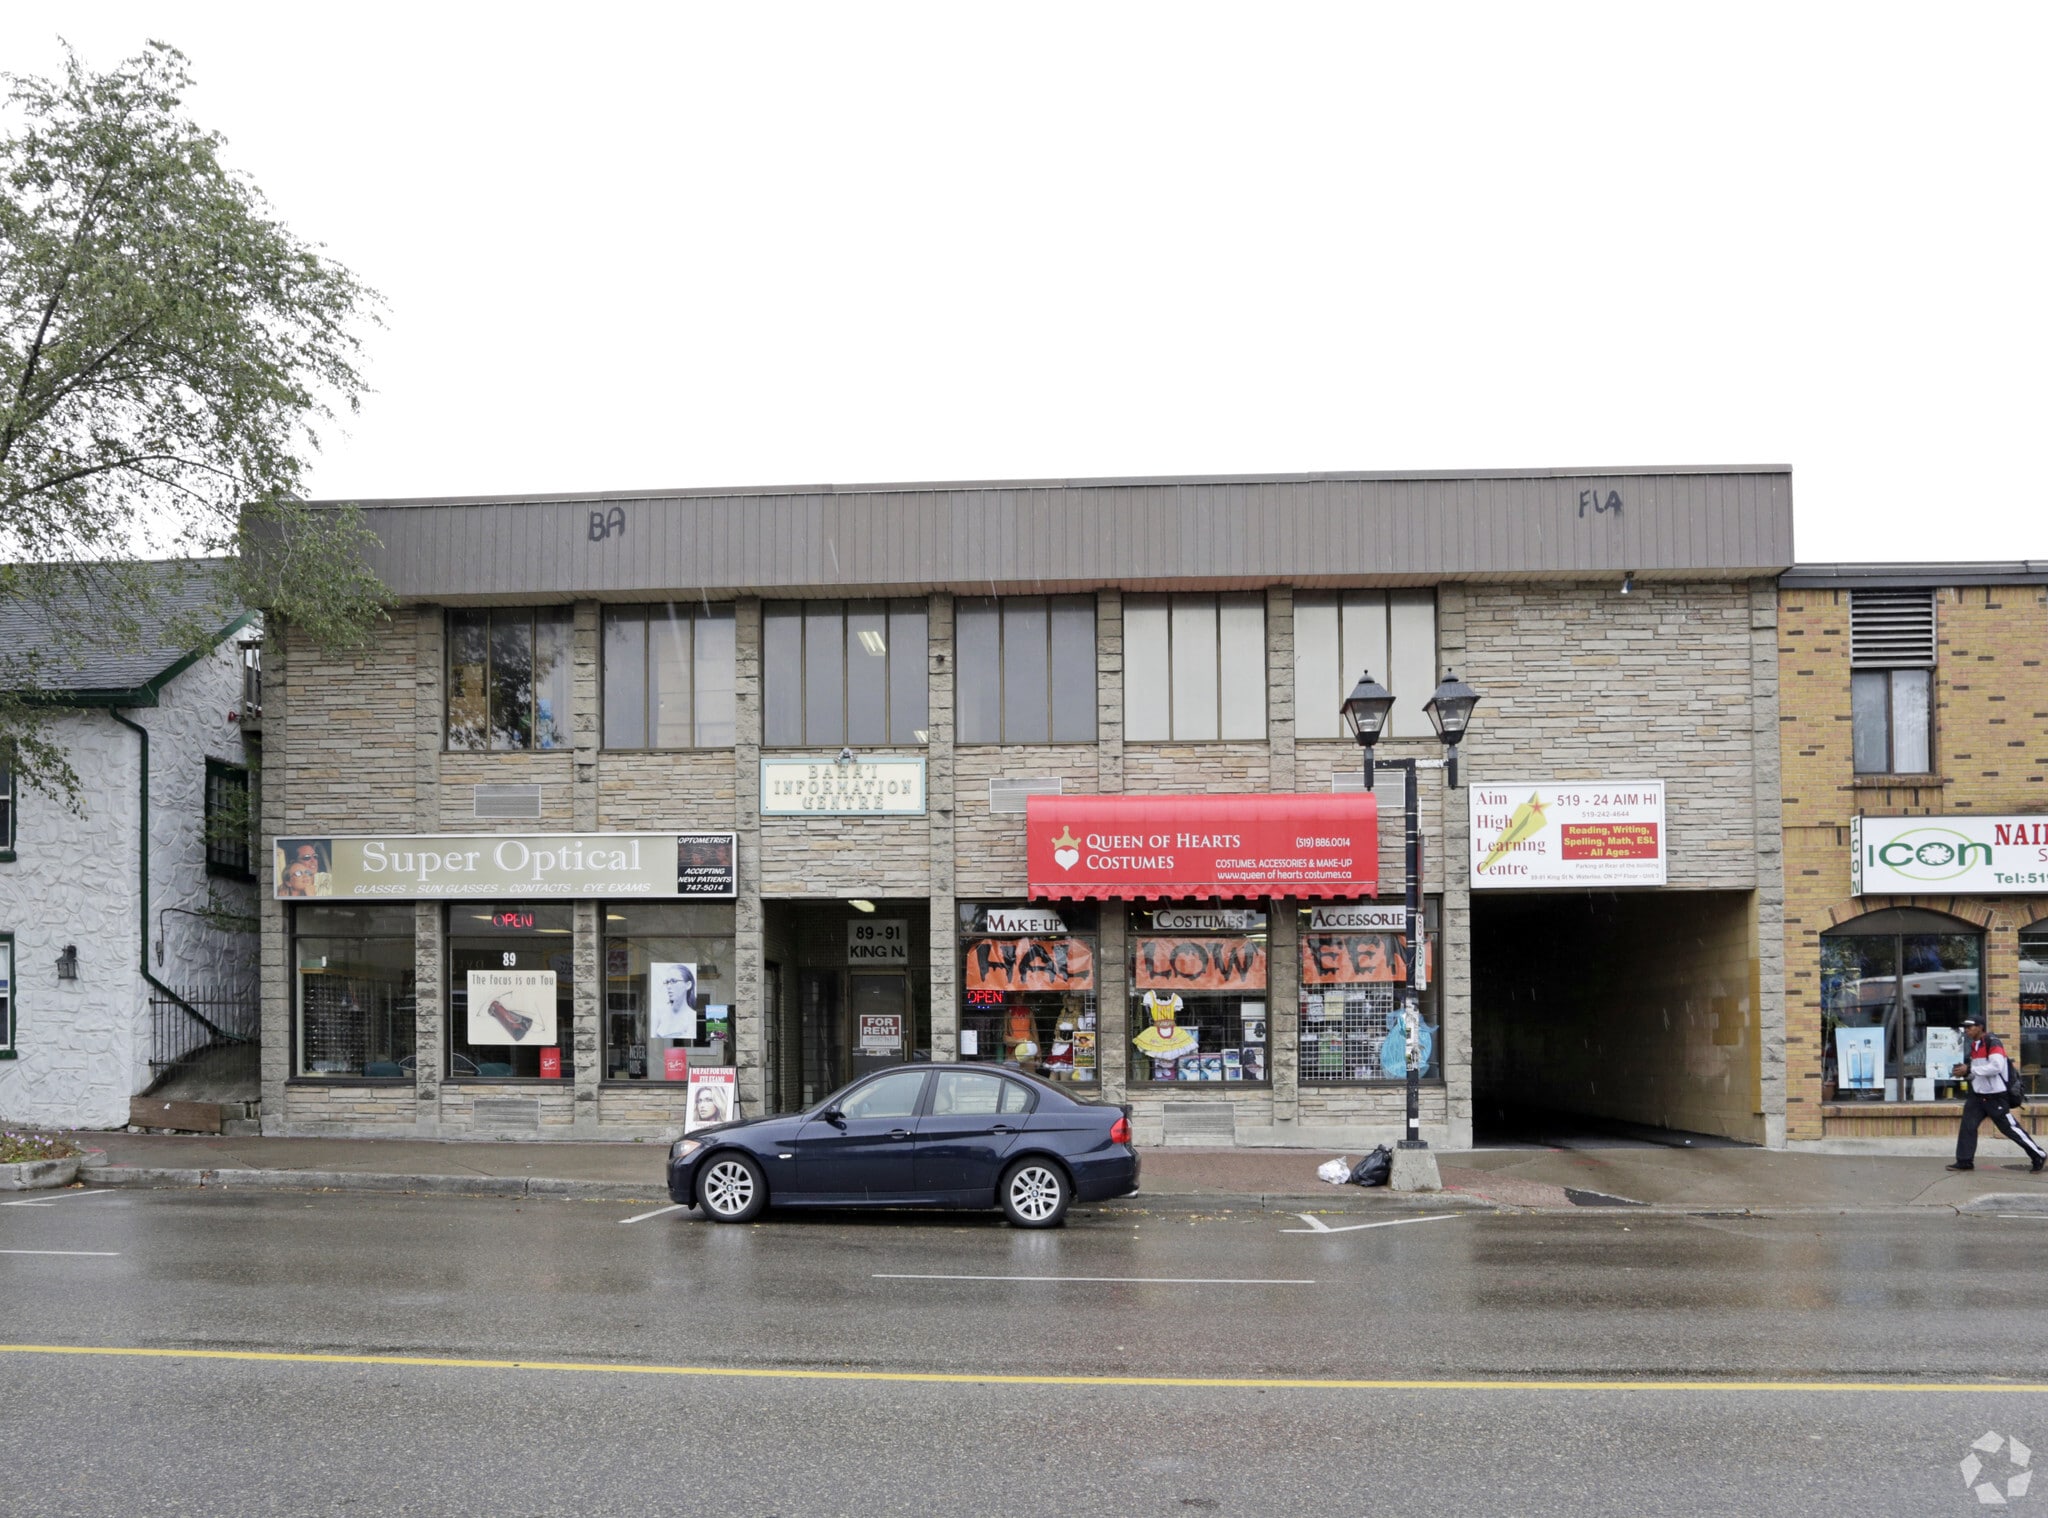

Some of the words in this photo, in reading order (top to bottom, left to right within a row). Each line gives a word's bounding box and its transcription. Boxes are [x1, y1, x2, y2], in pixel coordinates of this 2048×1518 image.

[774, 780, 912, 795] INFORMATION
[802, 795, 884, 810] CENTRE
[1476, 791, 1507, 805] Aim
[1557, 794, 1580, 806] 519
[1593, 794, 1608, 806] 24
[1613, 794, 1638, 805] AIM
[1643, 793, 1657, 805] HI
[1477, 814, 1513, 832] High
[1569, 826, 1610, 835] Reading,
[1612, 825, 1650, 834] Writing,
[1296, 837, 1314, 848] (519)
[1315, 837, 1350, 847] 886.0014
[1477, 837, 1546, 855] Learning
[1564, 837, 1605, 847] Spelling,
[1607, 837, 1634, 846] Math,
[1636, 836, 1655, 845] ESL
[1590, 848, 1603, 856] All
[1606, 848, 1630, 858] Ages
[362, 841, 480, 881] Super
[494, 839, 642, 880] Optical
[1259, 859, 1306, 868] ACCESSORIES
[1308, 858, 1315, 867] &
[1316, 858, 1352, 867] MAKE-UP
[1267, 869, 1276, 879] of
[1277, 869, 1302, 879] hearts
[1302, 870, 1352, 879] costumes.ca
[1477, 862, 1528, 875] Centre
[354, 885, 406, 893] GLASSES
[417, 884, 444, 893] SUN
[446, 884, 498, 893] GLASSES
[510, 884, 571, 893] CONTACTS
[583, 883, 605, 893] EYE
[607, 883, 651, 893] EXAMS
[493, 913, 534, 928] OPEN
[1313, 909, 1405, 927] ACCESSORIE
[850, 945, 887, 958] KING
[503, 952, 516, 966] 89
[976, 943, 1090, 984] HAL
[1142, 941, 1259, 982] LOW
[472, 974, 486, 985] The
[515, 975, 522, 985] is
[526, 976, 536, 985] on
[968, 991, 1003, 1004] OPEN
[867, 1017, 893, 1026] FOR
[863, 1026, 898, 1035] RENT
